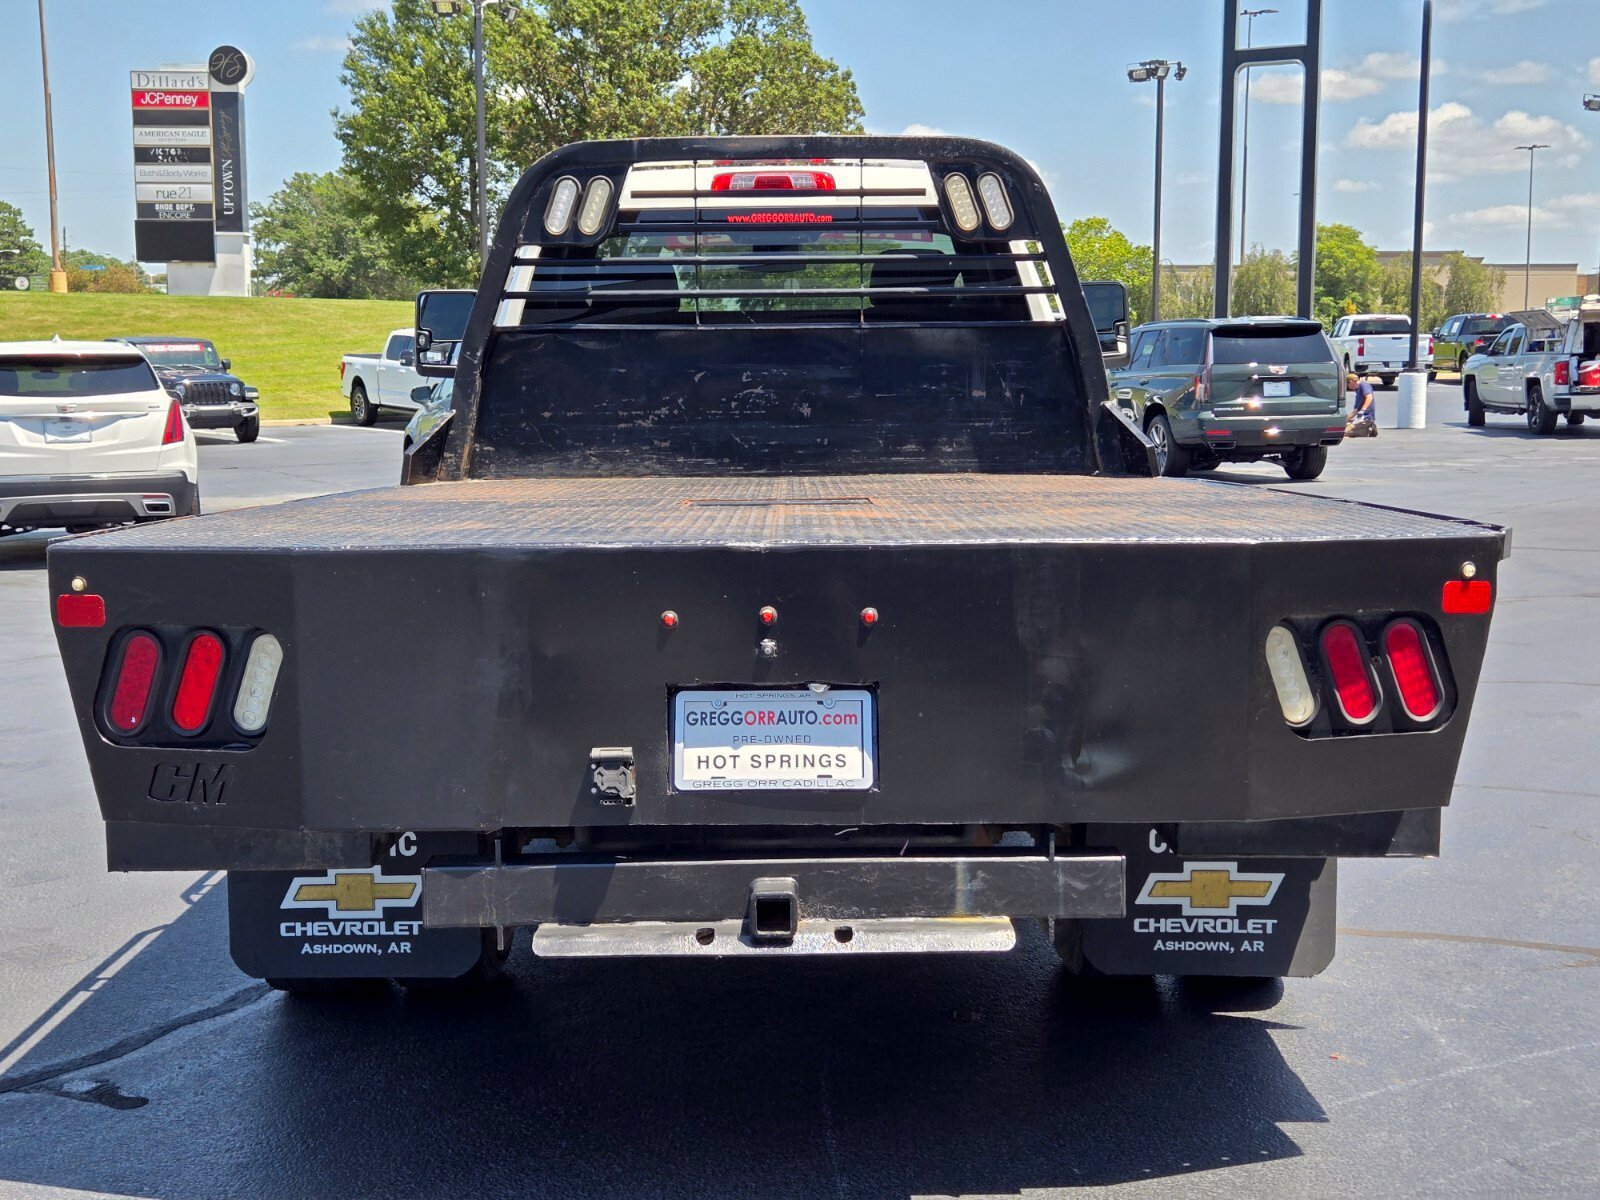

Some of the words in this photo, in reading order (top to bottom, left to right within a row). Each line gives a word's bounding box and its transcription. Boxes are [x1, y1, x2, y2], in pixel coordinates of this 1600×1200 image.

[137, 73, 205, 87] Dillard's
[141, 92, 198, 107] JCPenney
[222, 159, 235, 215] UPTOWN
[159, 211, 191, 219] ENCORE
[727, 213, 833, 223] www.GREGGORRAUTO.com
[686, 710, 858, 726] GREGGORRAUTO.com
[732, 735, 812, 744] PRE-OWNED
[697, 755, 740, 769] HOT
[750, 754, 847, 769] SPRINGS
[147, 761, 237, 805] CM
[692, 780, 744, 788] GREGG
[747, 780, 778, 788] ORR
[782, 779, 856, 788] CADILLAC
[279, 920, 424, 937] CHEVROLET
[1133, 918, 1278, 934] CHEVROLET
[387, 942, 412, 954] AR
[1240, 940, 1265, 952] AR
